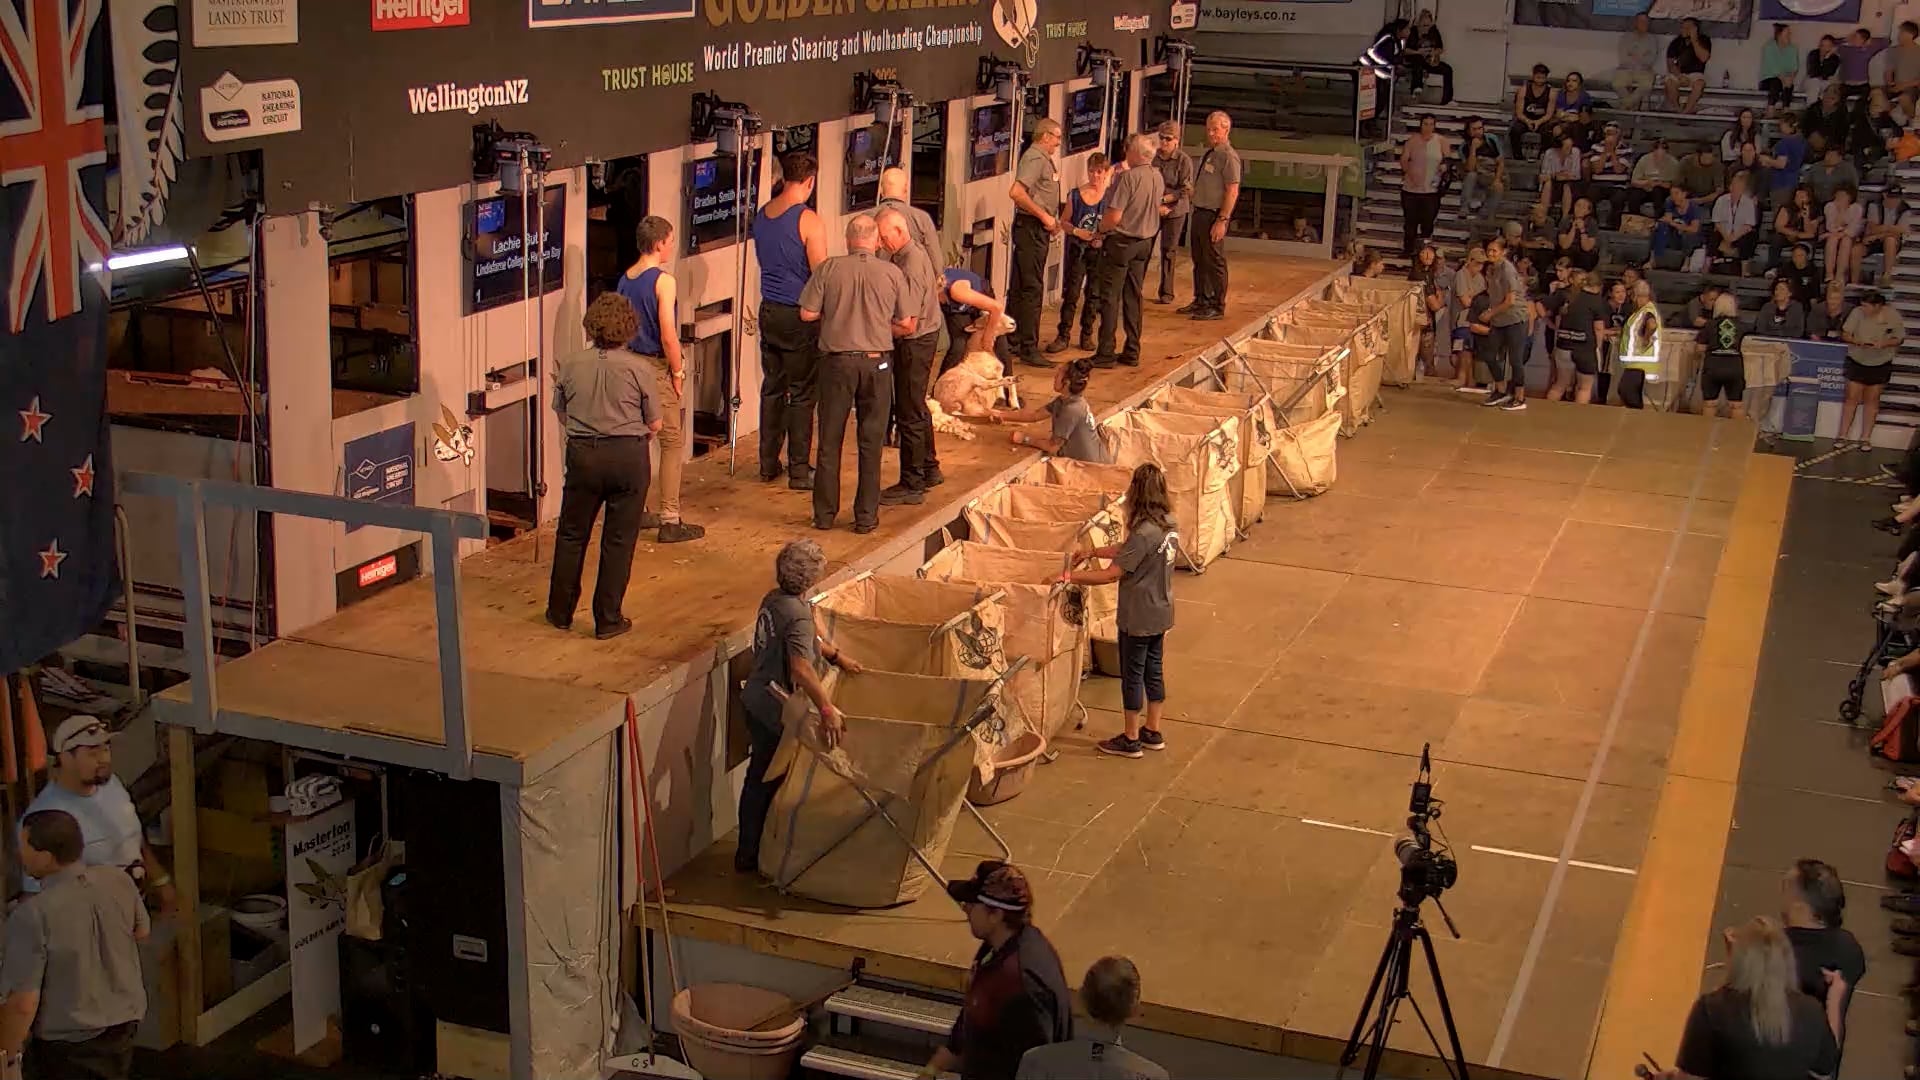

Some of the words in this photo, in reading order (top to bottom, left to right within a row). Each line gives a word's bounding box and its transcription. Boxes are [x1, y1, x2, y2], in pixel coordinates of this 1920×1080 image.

[208, 10, 248, 26] LANDS
[250, 9, 287, 25] TRUST
[703, 41, 740, 73] World
[744, 38, 788, 69] Premier
[791, 36, 839, 62] Shearing
[842, 31, 860, 56] and
[862, 25, 924, 54] Woolhandling
[925, 20, 983, 49] Championship
[602, 66, 647, 91] TRUST
[651, 61, 695, 87] HOUSE
[408, 79, 529, 115] WellingtonNZ
[691, 234, 697, 248] 2
